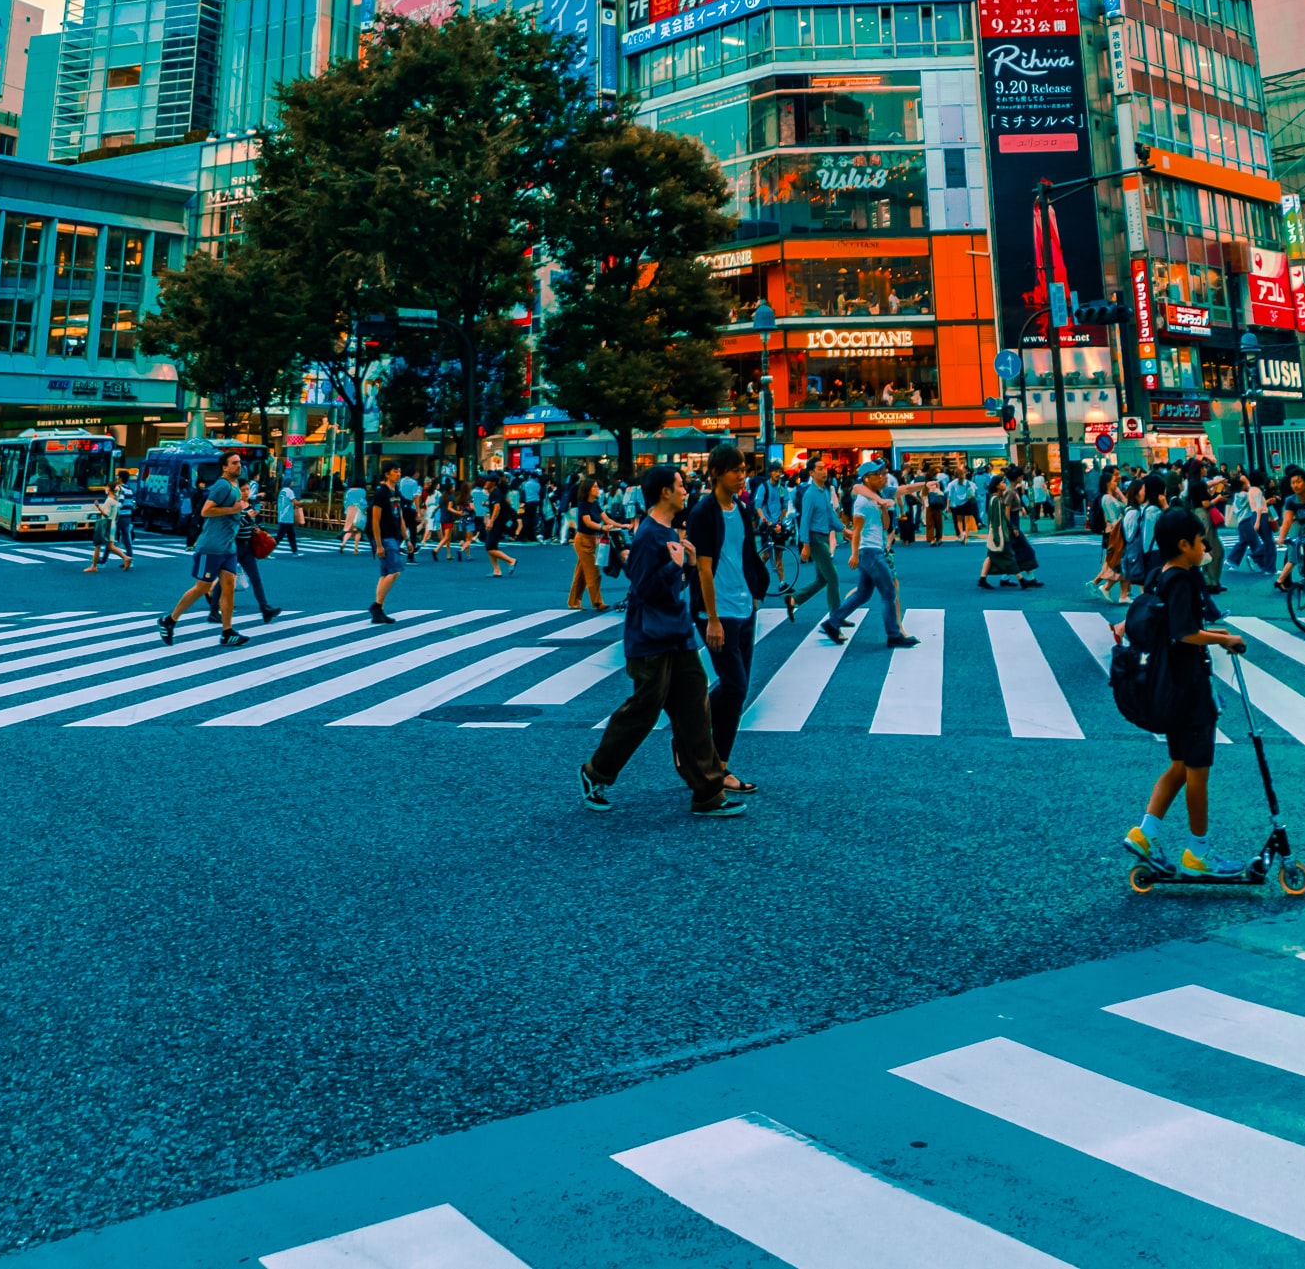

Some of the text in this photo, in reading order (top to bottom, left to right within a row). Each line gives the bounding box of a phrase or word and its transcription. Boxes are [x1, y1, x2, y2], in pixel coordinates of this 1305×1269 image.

[627, 29, 652, 46] AEON
[987, 45, 1074, 76] Rihwa
[995, 80, 1072, 94] 9.20 Release
[991, 113, 1084, 129] 「ミチシルベ」
[817, 167, 888, 189] Ushi8
[1257, 280, 1285, 302] アコム
[1136, 281, 1150, 338] サンドラッグ
[807, 329, 913, 348] L'OCCITANE
[1259, 359, 1302, 388] LUSH
[1166, 403, 1200, 417] サンドラッグ
